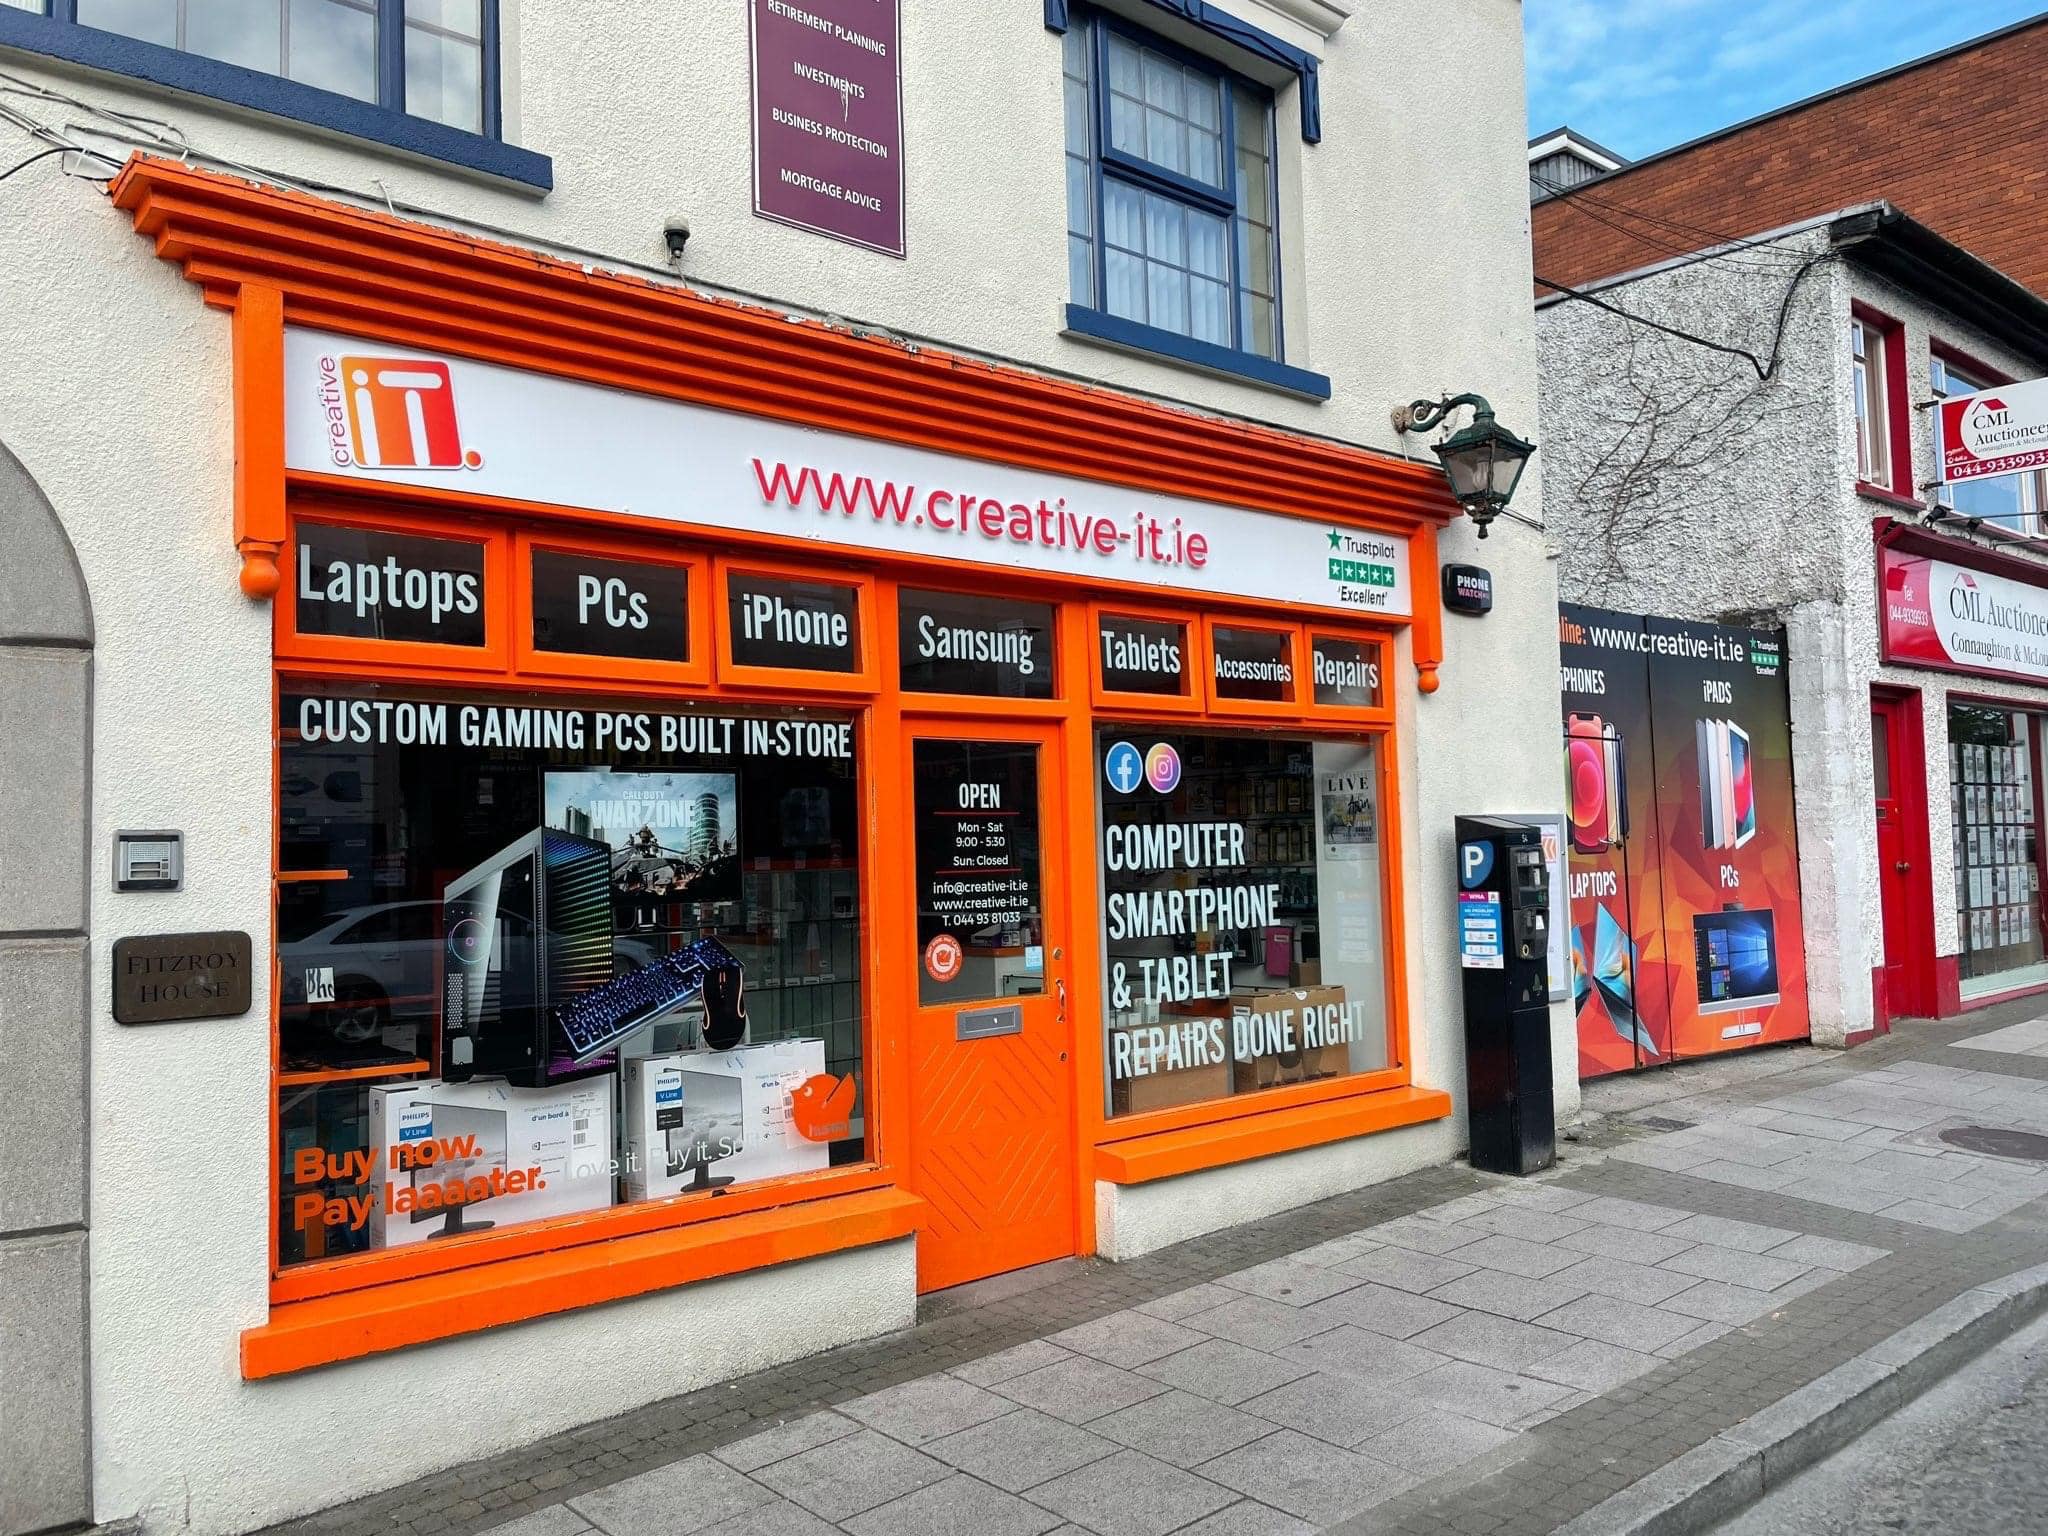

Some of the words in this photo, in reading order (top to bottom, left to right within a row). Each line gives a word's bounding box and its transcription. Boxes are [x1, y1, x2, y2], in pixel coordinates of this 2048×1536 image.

[767, 0, 833, 34] RETIREMENT
[836, 25, 886, 57] PLANNING
[793, 61, 865, 99] INVESTMENTS
[772, 107, 823, 136] BUSINESS
[825, 126, 888, 159] PROTECTION
[781, 168, 842, 200] MORTGAGE
[844, 190, 882, 212] ADVICE
[319, 356, 350, 464] creative
[1973, 411, 2014, 430] CML
[1974, 423, 2048, 446] Auctionee
[751, 457, 1208, 568] www.creative-it.ie
[1344, 535, 1395, 560] Trustpilot
[299, 544, 478, 623] Laptops
[1457, 575, 1489, 591] PHONE
[578, 575, 649, 630] PCs
[1949, 586, 1985, 623] CML
[1987, 594, 2048, 637] Auctione
[743, 593, 848, 648] iPhone
[918, 615, 1034, 674] Samsung
[1101, 630, 1181, 674] Tablets
[1558, 616, 1587, 645] line:
[1589, 625, 1744, 663] www.creative-it.ie
[1951, 632, 2012, 662] Connaughton
[2013, 643, 2021, 662] &
[1215, 653, 1292, 684] Accessories
[1313, 650, 1379, 700] Repairs
[1703, 680, 1732, 704] iPADS
[299, 698, 447, 745] CUSTOM
[460, 705, 584, 750] GAMING
[595, 712, 652, 752] PCS
[660, 714, 736, 756] BUILT
[743, 717, 853, 758] IN-STORE
[959, 783, 1000, 809] OPEN
[1328, 777, 1369, 791] LIVE
[590, 800, 697, 829] WARZONE
[957, 822, 980, 833] Mon
[987, 822, 1003, 833] Sat
[956, 836, 978, 847] 9:00
[985, 836, 1005, 847] 5:30
[1106, 823, 1245, 871] COMPUTER
[953, 856, 975, 867] Sun:
[976, 854, 1009, 866] Closed
[1464, 845, 1484, 879] P
[1720, 864, 1739, 888] PCs
[932, 880, 1028, 895] info@creative-it.ie
[932, 896, 1029, 911] www.creative-it.ie
[942, 915, 951, 926] T.
[953, 914, 974, 926] 044
[976, 913, 990, 924] 93
[991, 911, 1021, 924] 81033
[1108, 884, 1281, 940] SMARTPHONE
[127, 952, 241, 975] FITZROY
[1112, 962, 1132, 1009] &
[1139, 952, 1233, 1005] TABLET
[141, 981, 230, 1003] HOUSE
[1113, 1017, 1225, 1080] REPAIRS
[1232, 1009, 1296, 1060] DONE
[1303, 1000, 1365, 1049] RIGHT
[401, 1111, 430, 1121] PHILIPS
[547, 1111, 564, 1120] bord
[404, 1129, 410, 1137] V
[294, 1147, 379, 1186] Buy
[390, 1133, 484, 1170] now.
[626, 1151, 642, 1174] it.
[655, 1147, 692, 1171] uy
[696, 1140, 712, 1162] it.
[294, 1192, 375, 1232] Pay
[385, 1166, 546, 1216] laaater.
